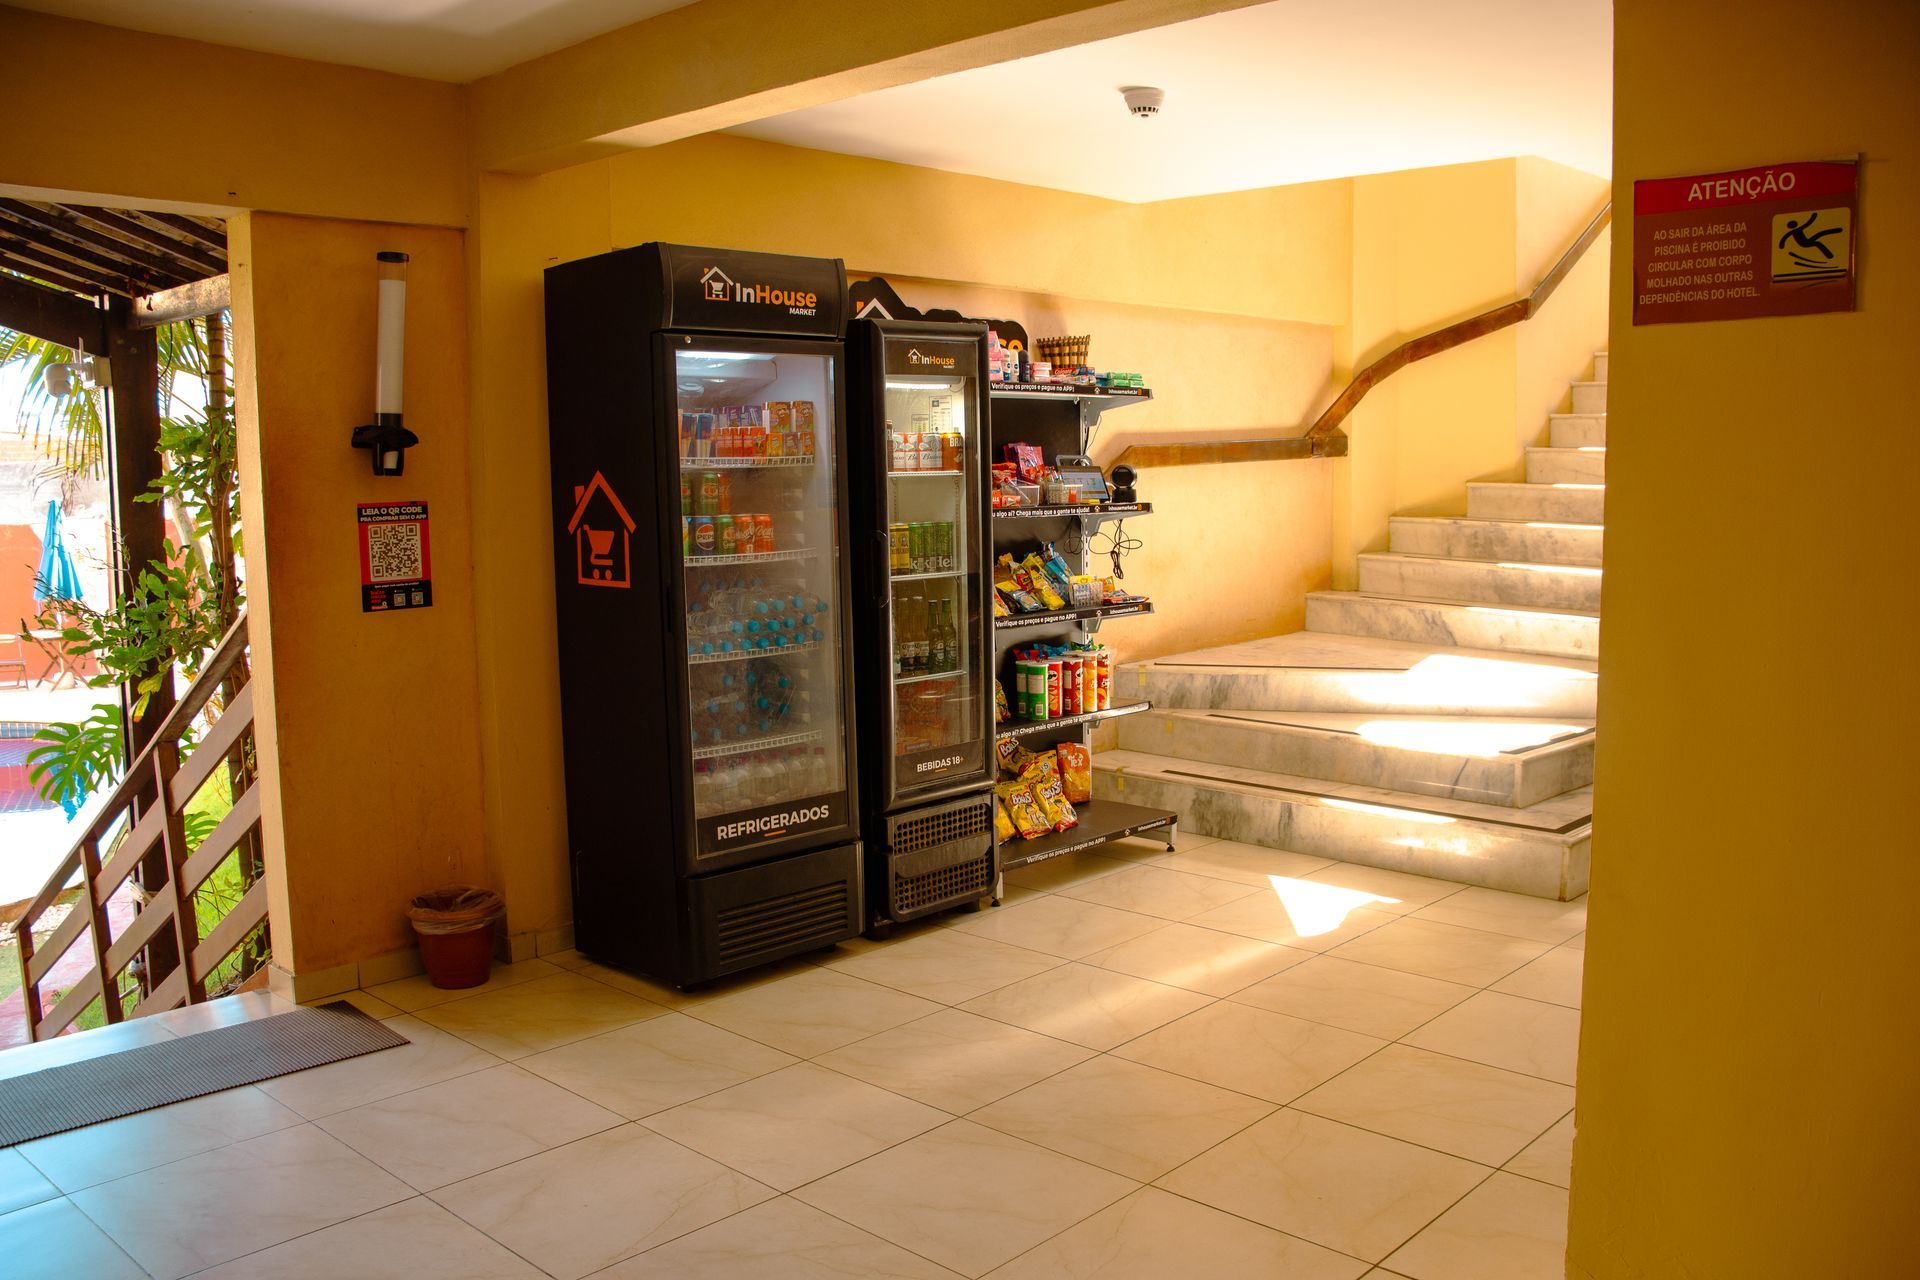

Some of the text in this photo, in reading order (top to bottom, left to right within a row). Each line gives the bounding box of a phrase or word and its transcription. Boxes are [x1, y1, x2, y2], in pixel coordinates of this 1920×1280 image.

[1687, 170, 1796, 201] ATENÇÃO
[1653, 222, 1747, 241] AO SAIR DA ÁREA DA
[1654, 238, 1746, 256] PISCINA É PROIBIDO
[1648, 255, 1752, 272] CIRCULAR COM CORPO
[1647, 271, 1753, 288] MOLHADO NAS OUTRAS
[735, 282, 817, 307] InHouse
[1640, 287, 1760, 305] DEPENDÊNCIAS DO HOTEL.
[789, 307, 816, 316] MARKET
[921, 355, 955, 365] InHouse
[991, 383, 1014, 391] Verifique
[388, 507, 400, 515] QR
[1016, 510, 1031, 518] Chega
[1059, 508, 1070, 516] gente
[996, 620, 1018, 628] Verifique
[1024, 618, 1040, 626] preços
[1044, 616, 1058, 624] pague
[1000, 731, 1011, 739] algo
[1011, 728, 1019, 736] aí?
[1020, 726, 1035, 735] Chega
[1035, 723, 1046, 731] mais
[1046, 722, 1056, 730] que
[1060, 719, 1073, 727] gente
[916, 758, 952, 773] BEBIDAS
[717, 805, 829, 840] REFRIGERADOS
[1026, 853, 1048, 863] Verifique
[1054, 847, 1070, 857] preços
[1074, 842, 1088, 851] pague
